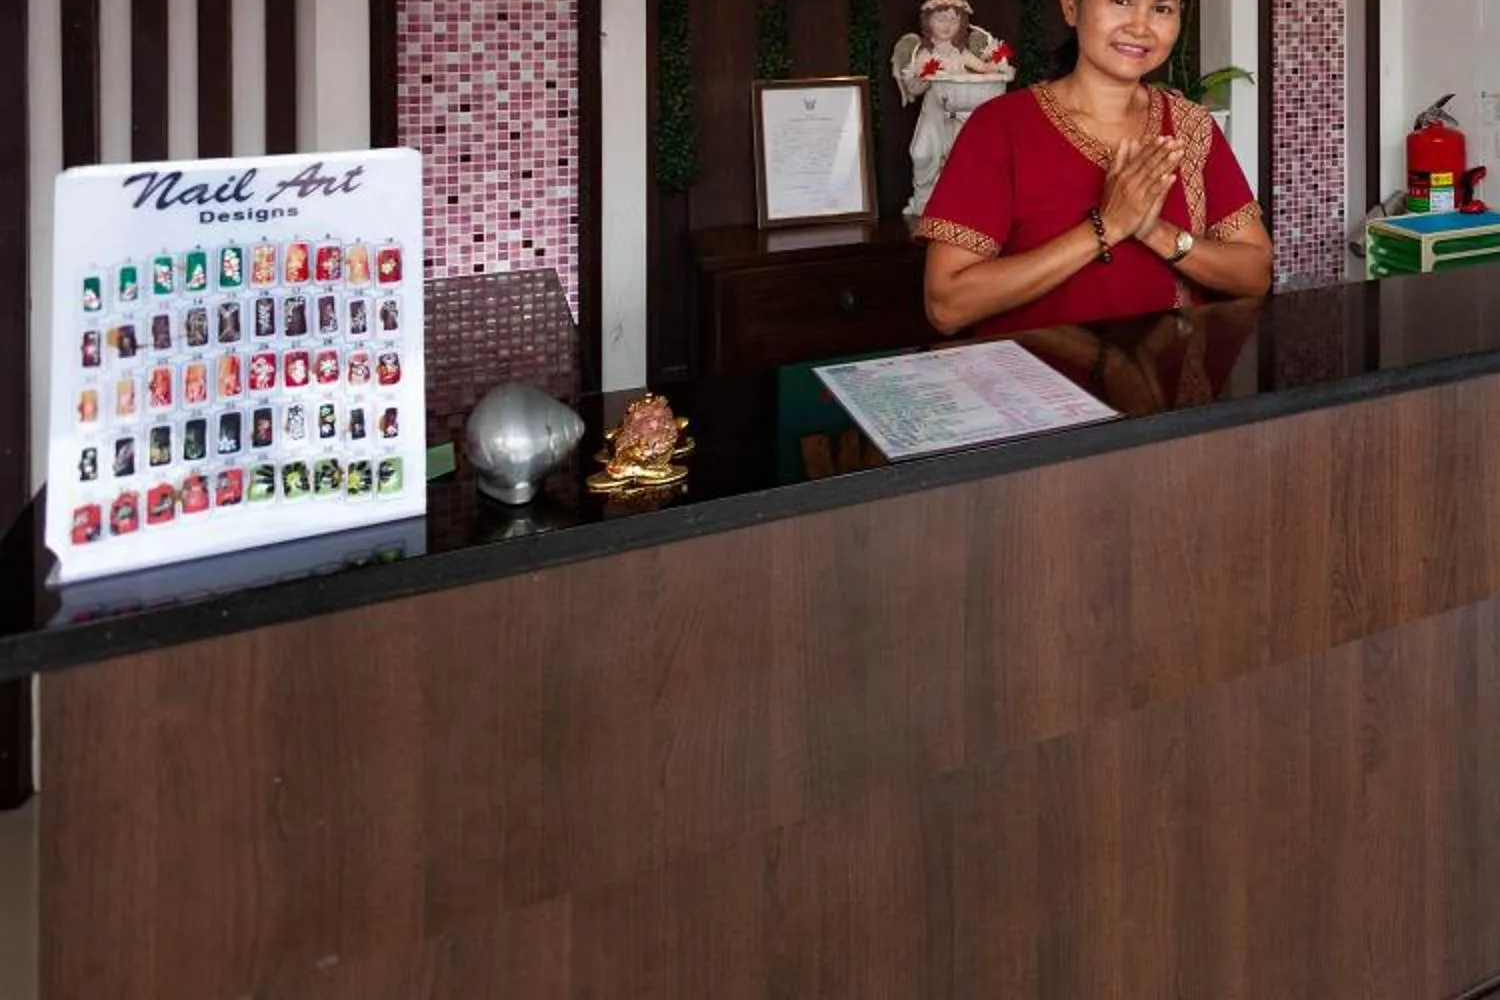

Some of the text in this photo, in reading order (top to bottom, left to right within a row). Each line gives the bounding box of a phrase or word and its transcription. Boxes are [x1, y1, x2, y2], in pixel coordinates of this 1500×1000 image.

[122, 161, 365, 211] Nail Art
[199, 206, 299, 225] Designs
